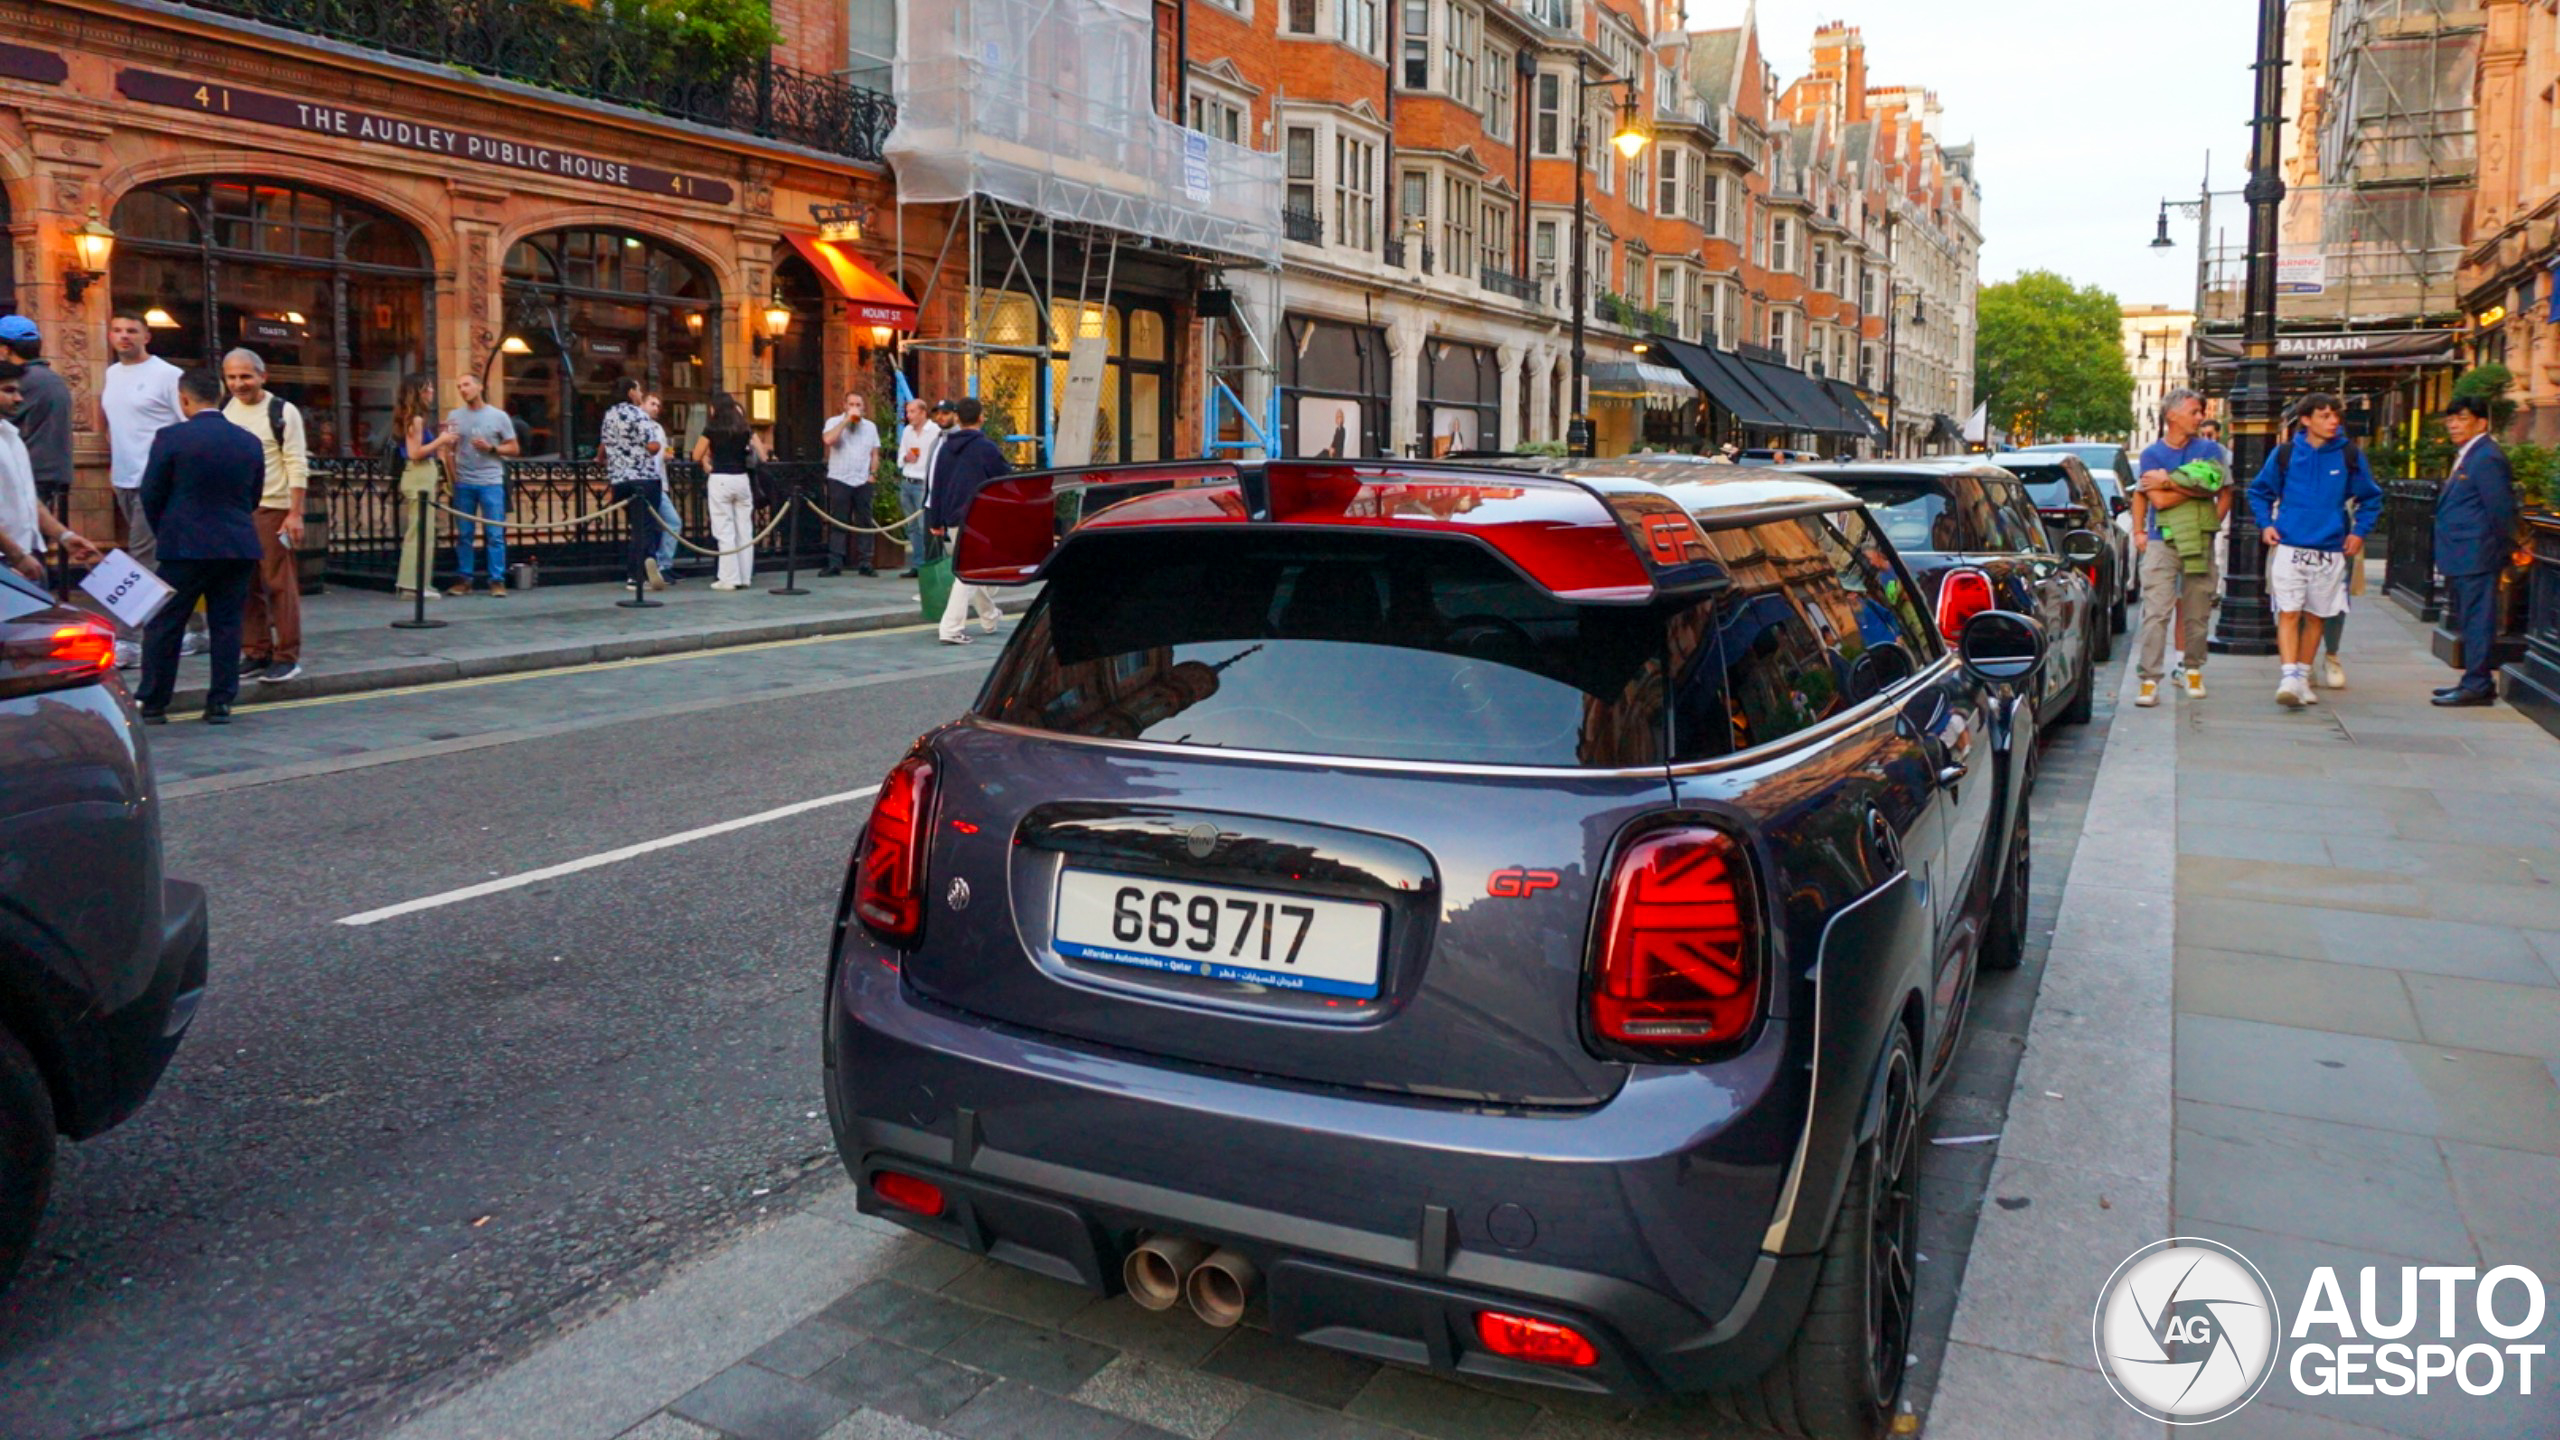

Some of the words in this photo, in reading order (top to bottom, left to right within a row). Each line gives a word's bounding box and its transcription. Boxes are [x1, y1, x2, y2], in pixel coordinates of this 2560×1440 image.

[298, 104, 348, 133] THE
[360, 116, 455, 152] AUDLEY
[468, 136, 550, 171] PUBLIC
[560, 154, 630, 184] HOUSE
[2276, 258, 2320, 267] ARNING!
[861, 307, 890, 318] MOUNT
[891, 311, 902, 321] ST.
[2280, 337, 2368, 352] BALMAIN
[2306, 353, 2340, 362] PARIS
[106, 571, 141, 605] BOSS
[1190, 836, 1215, 847] MINI
[1487, 869, 1559, 898] GP
[1112, 886, 1314, 965] 669717
[1114, 953, 1163, 969] Automobiles
[1170, 961, 1192, 972] Qatar
